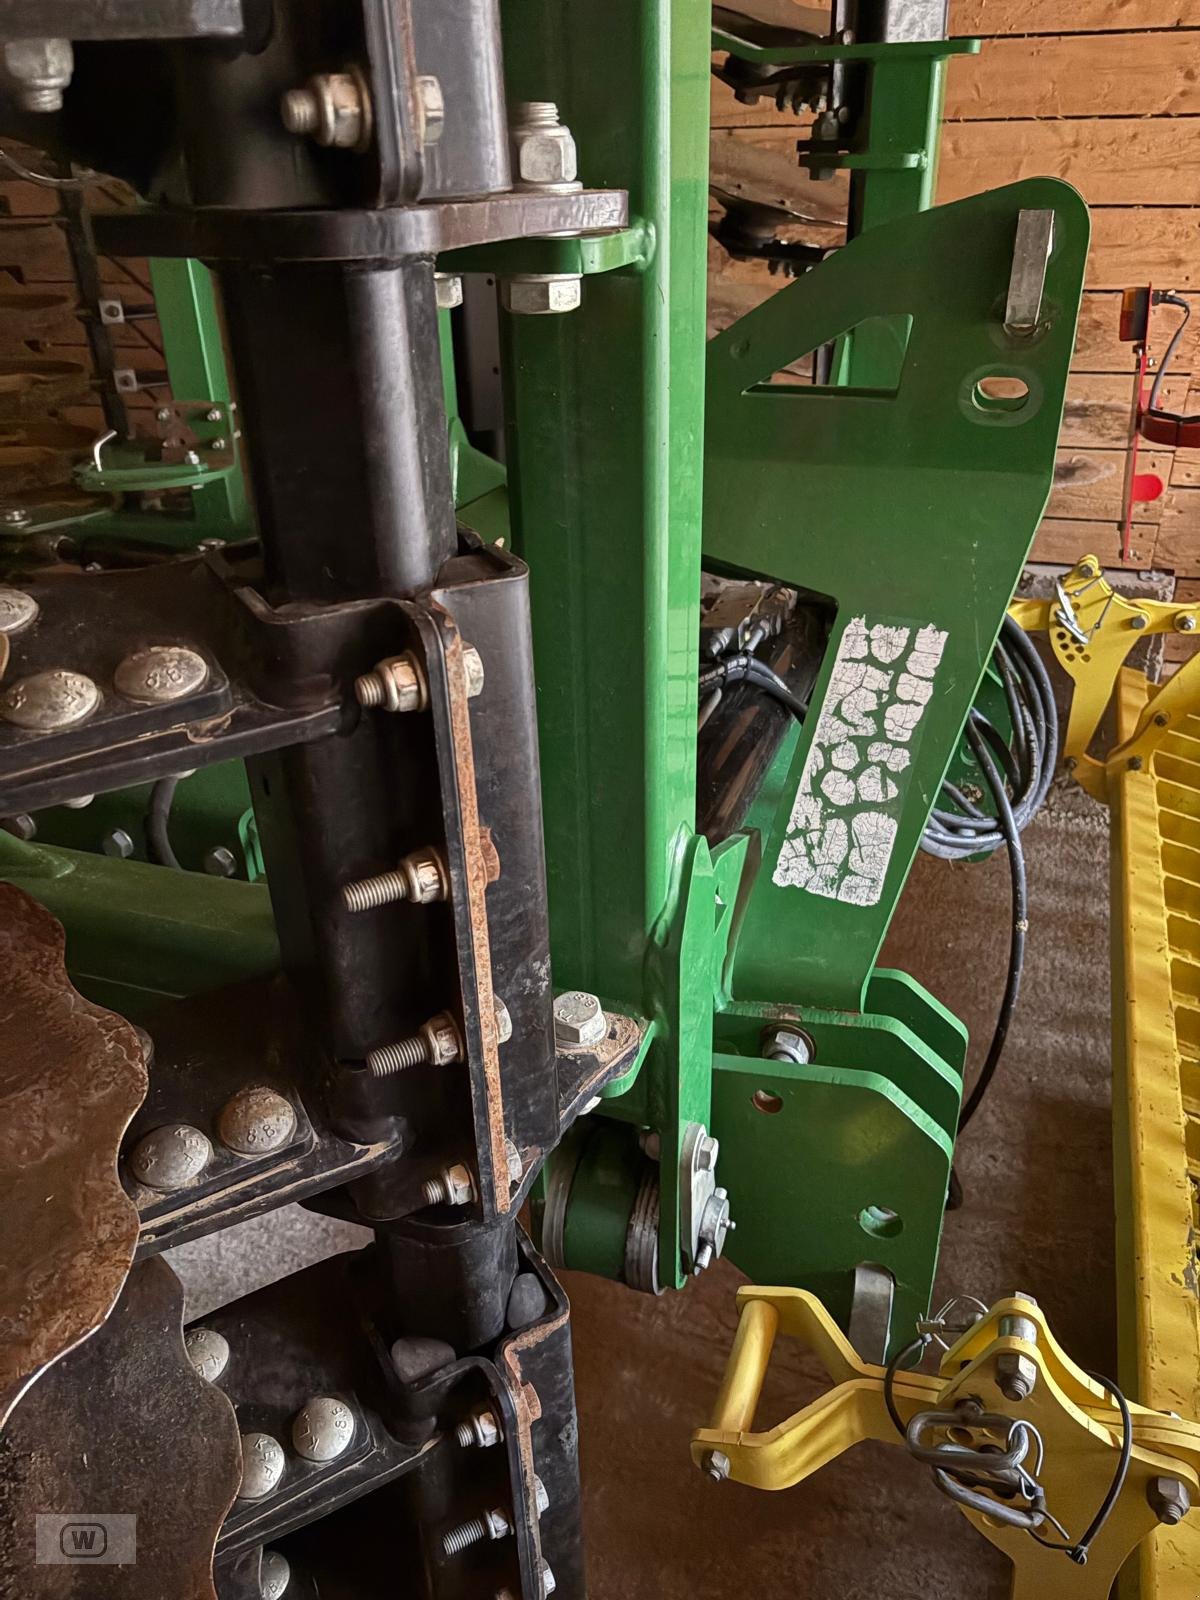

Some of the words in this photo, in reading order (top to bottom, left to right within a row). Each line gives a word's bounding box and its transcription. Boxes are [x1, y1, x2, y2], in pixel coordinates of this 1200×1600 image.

[574, 992, 596, 1008] 8.8
[173, 1127, 202, 1170] KEF
[246, 1124, 276, 1144] 8.8
[253, 1438, 279, 1481] KEF
